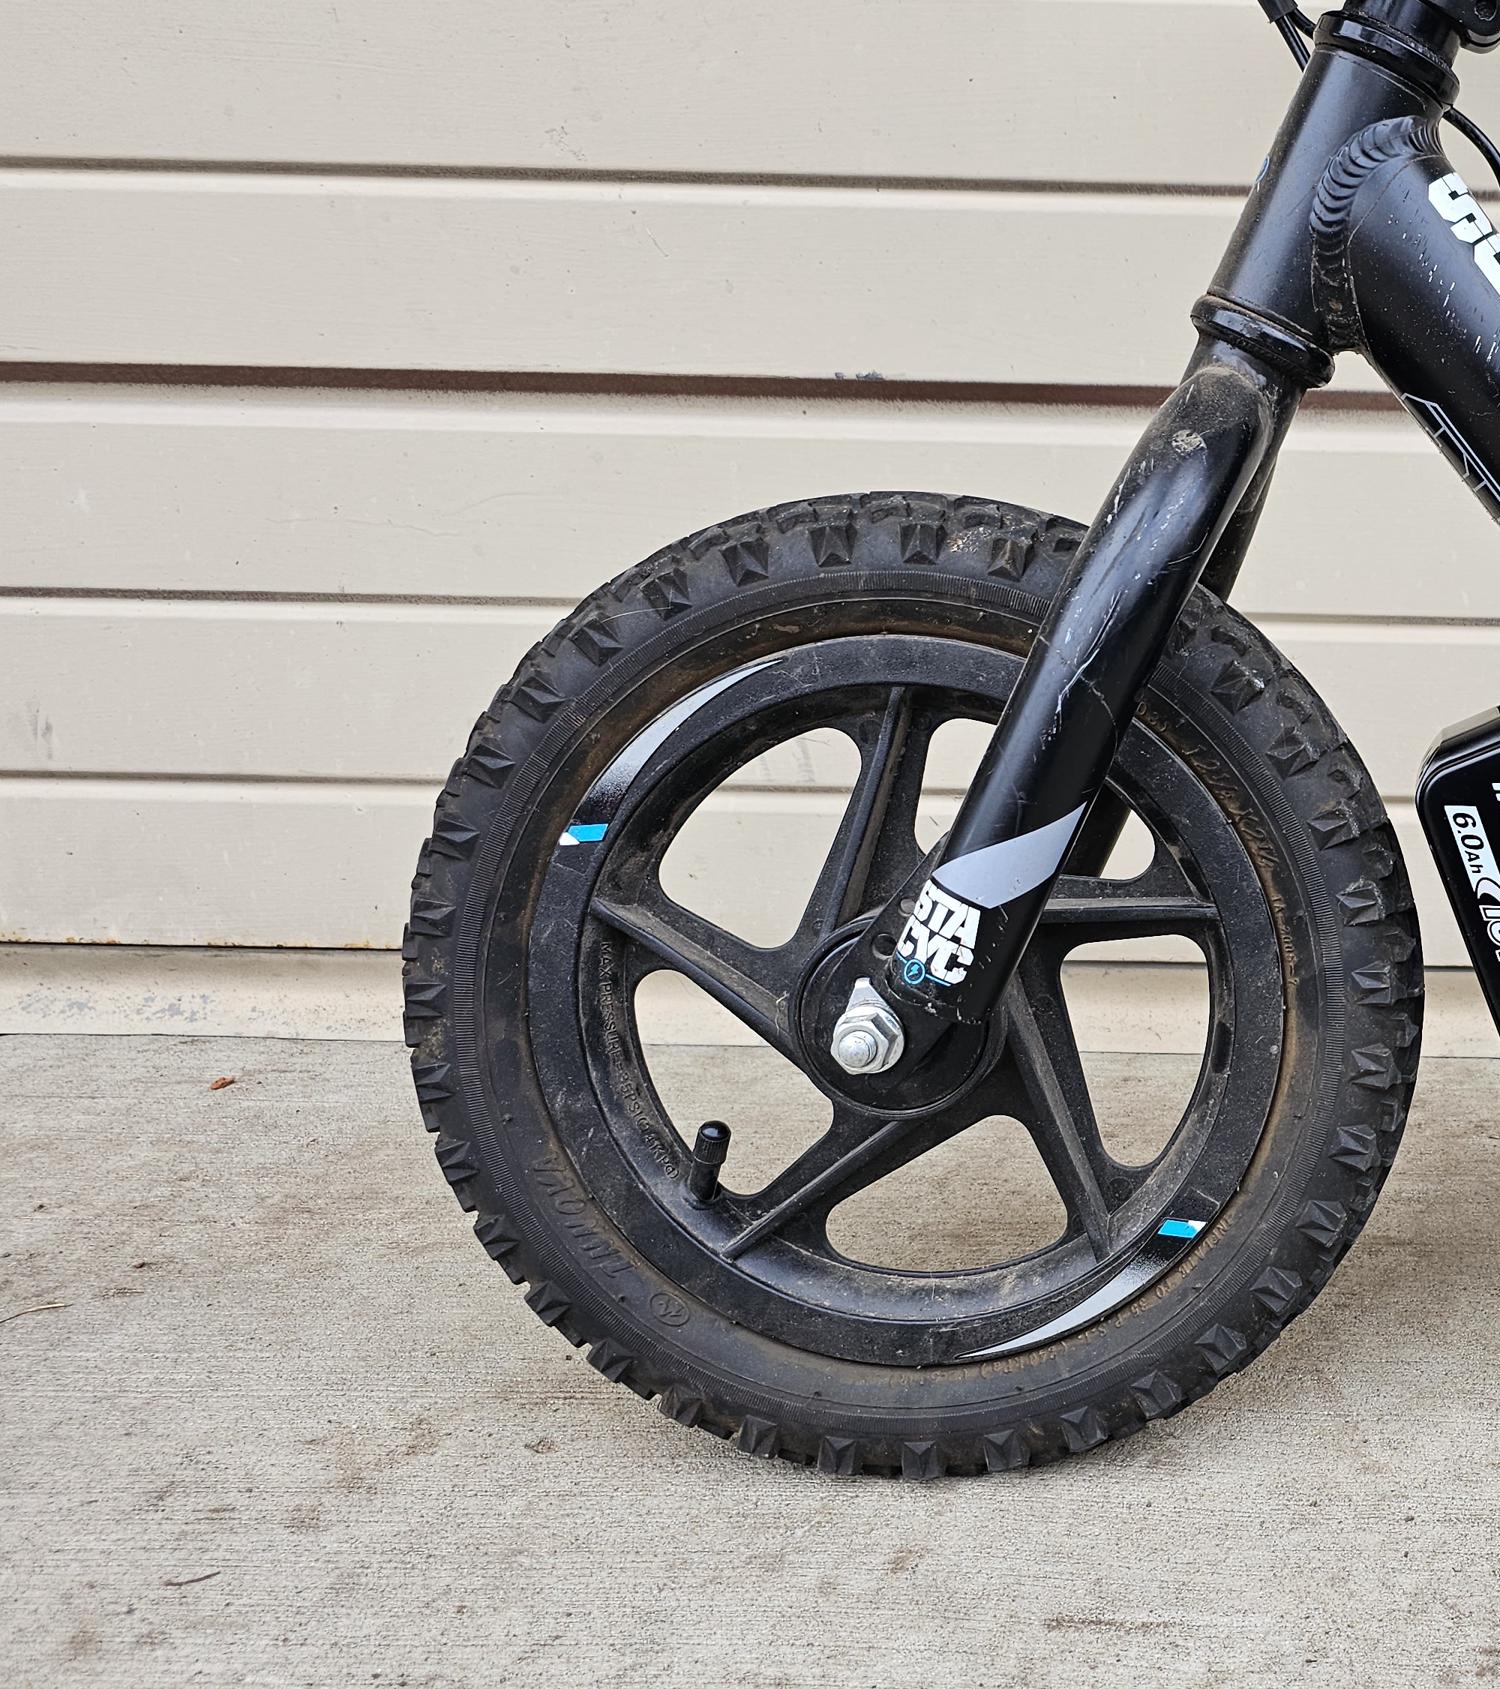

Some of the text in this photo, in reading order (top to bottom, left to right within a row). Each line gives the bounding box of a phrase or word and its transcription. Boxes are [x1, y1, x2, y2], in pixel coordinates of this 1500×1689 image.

[1454, 812, 1483, 875] 6.0Ah
[897, 913, 975, 984] CYC
[914, 879, 981, 949] STA
